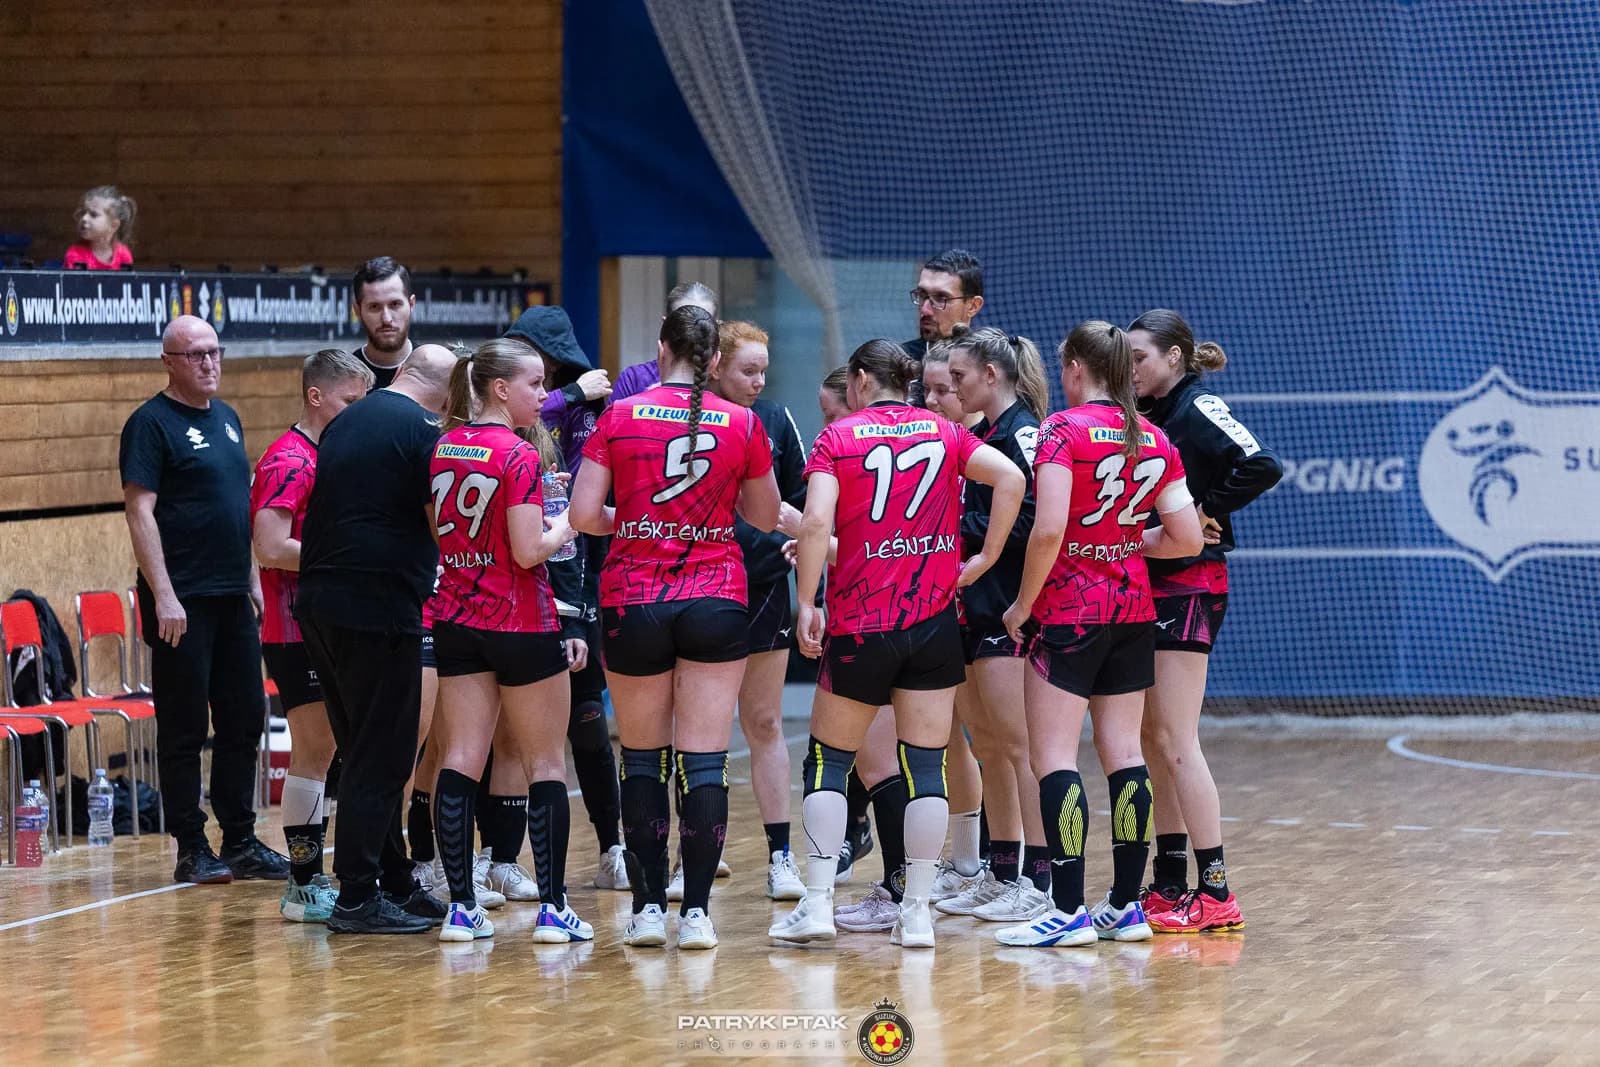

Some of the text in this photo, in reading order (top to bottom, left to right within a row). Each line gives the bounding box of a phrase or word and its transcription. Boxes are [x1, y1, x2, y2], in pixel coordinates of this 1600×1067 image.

[22, 283, 167, 336] www.koronahandball.pl
[656, 408, 724, 424] LEWITAN
[876, 421, 933, 436] LEWIATAN
[445, 446, 487, 459] LEWIATAN
[651, 431, 718, 505] 5
[863, 439, 946, 522] 17
[1080, 453, 1167, 527] 32
[865, 530, 956, 560] LEŚNIAK
